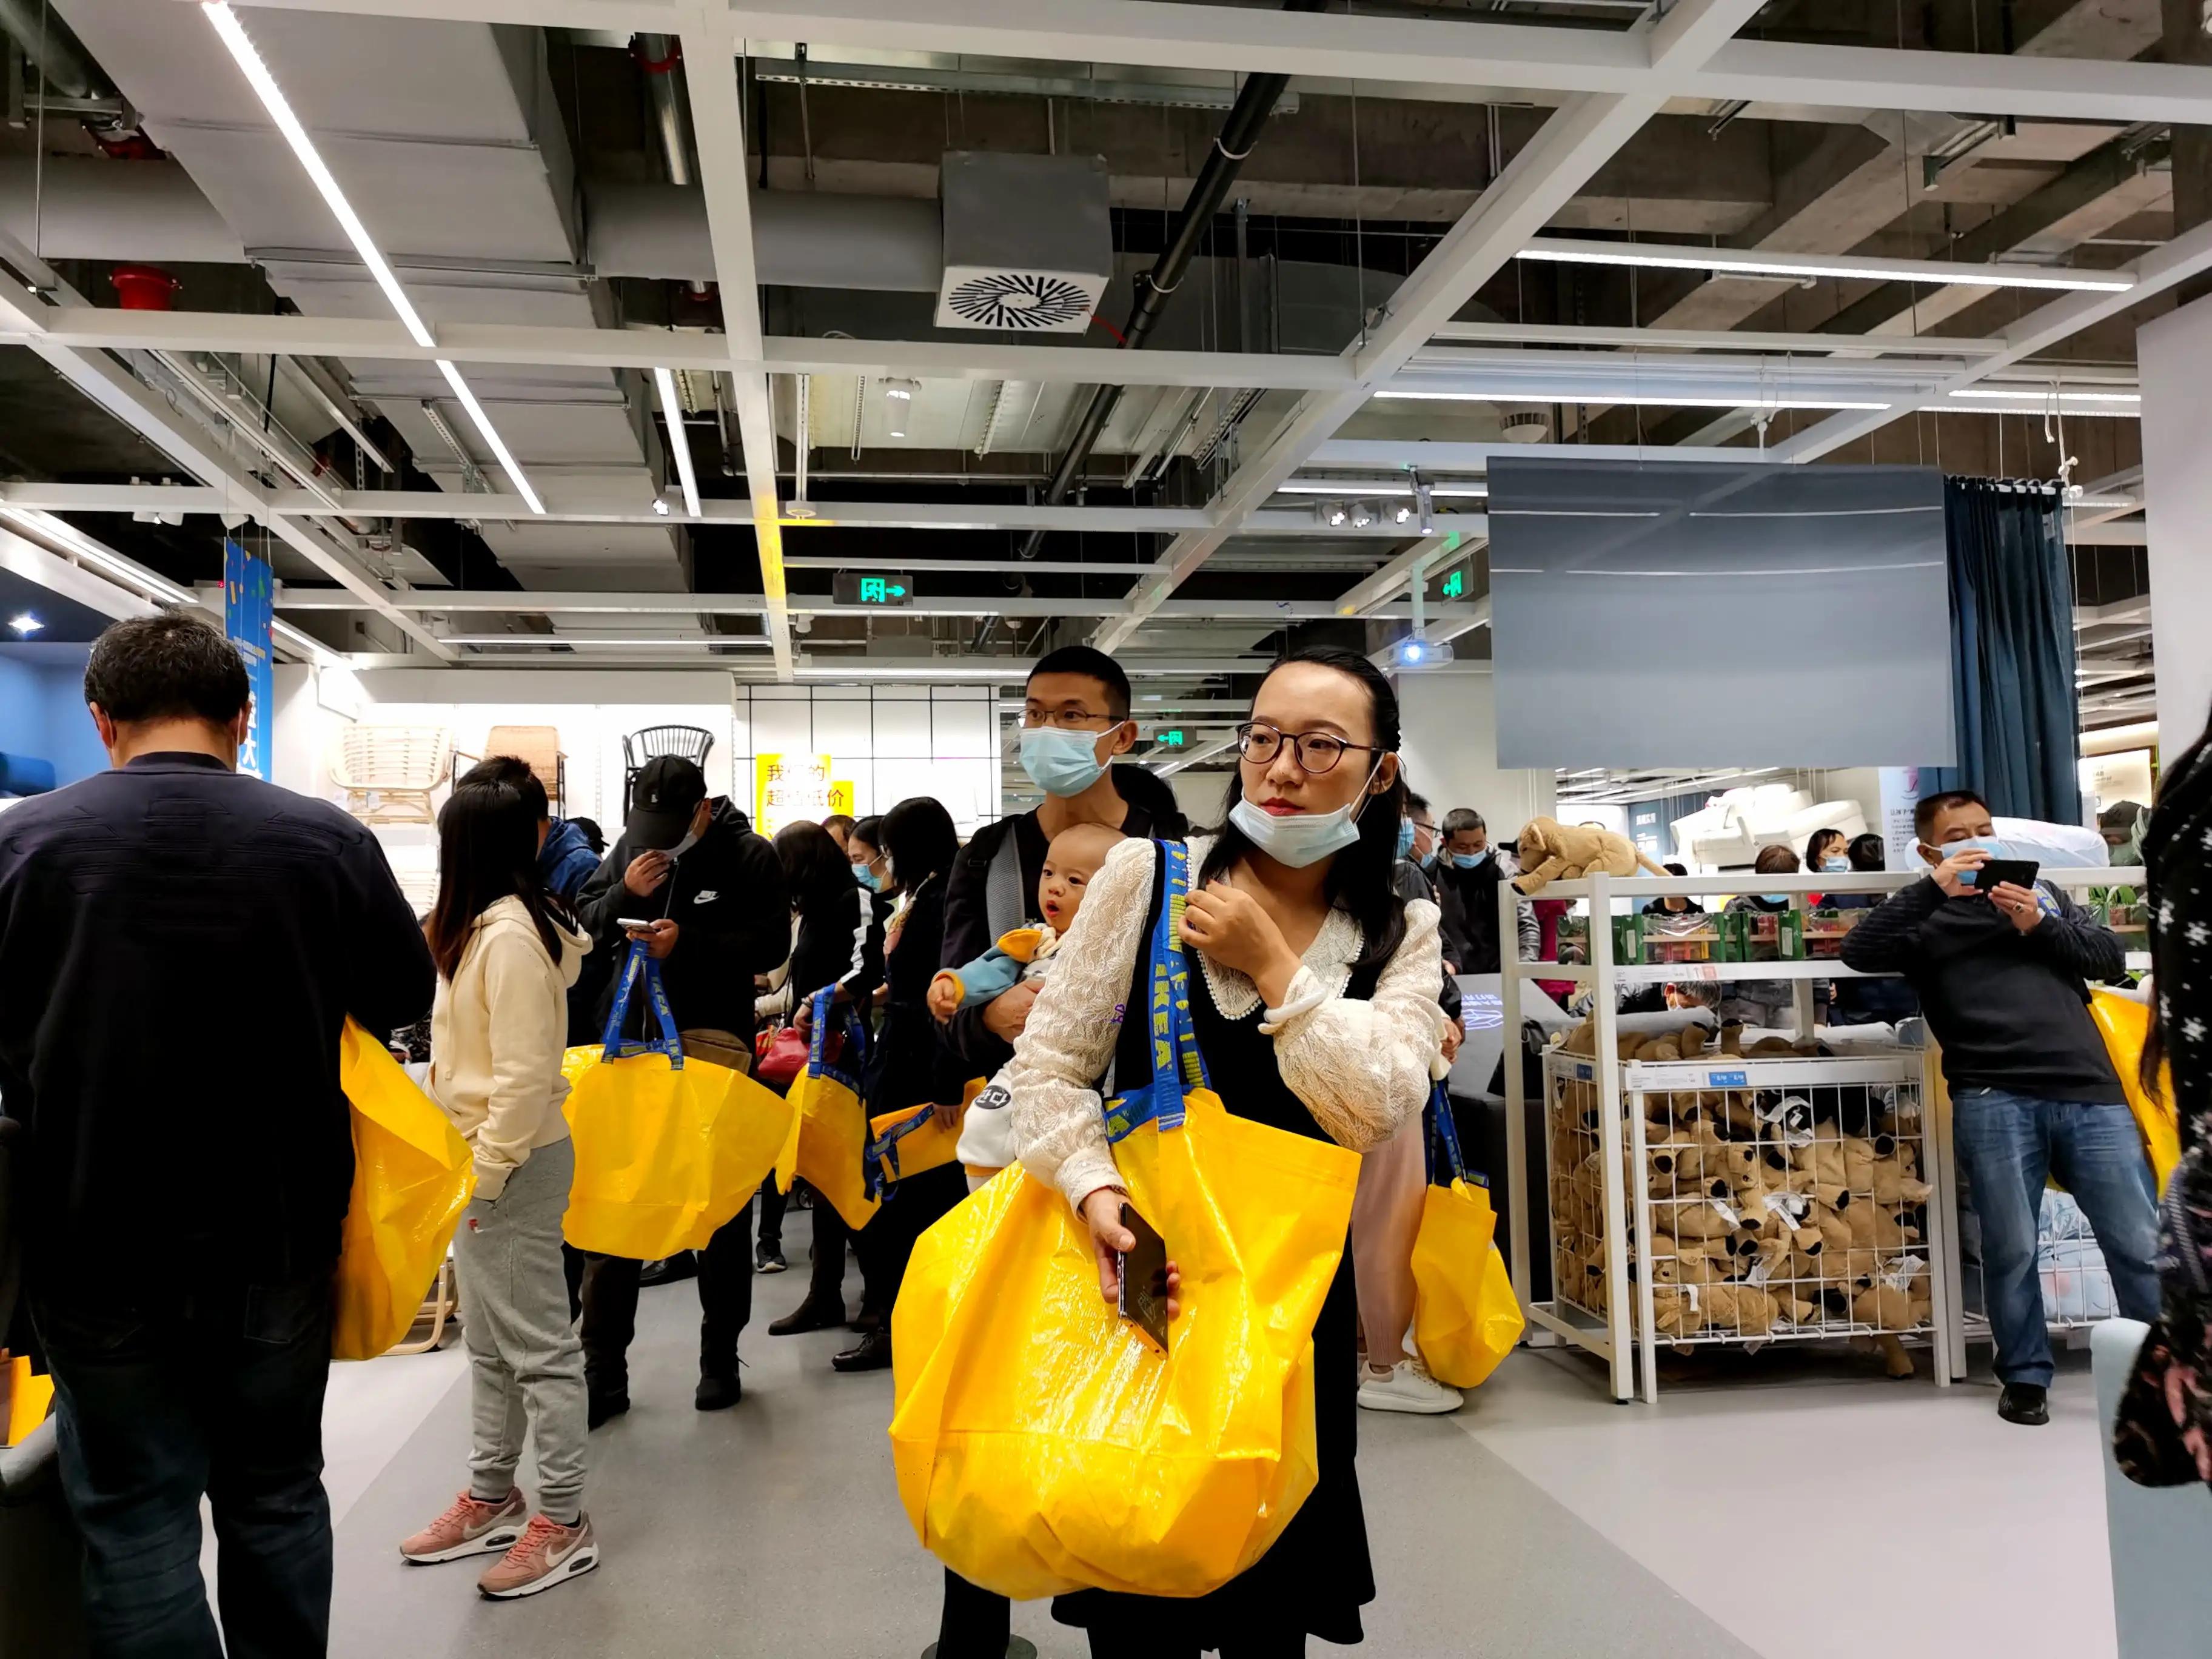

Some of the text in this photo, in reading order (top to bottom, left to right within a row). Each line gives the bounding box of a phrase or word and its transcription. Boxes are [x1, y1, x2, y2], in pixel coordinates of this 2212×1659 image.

[766, 764, 825, 782] 我的
[766, 789, 844, 807] 超低价
[1153, 964, 1172, 1070] IKEA
